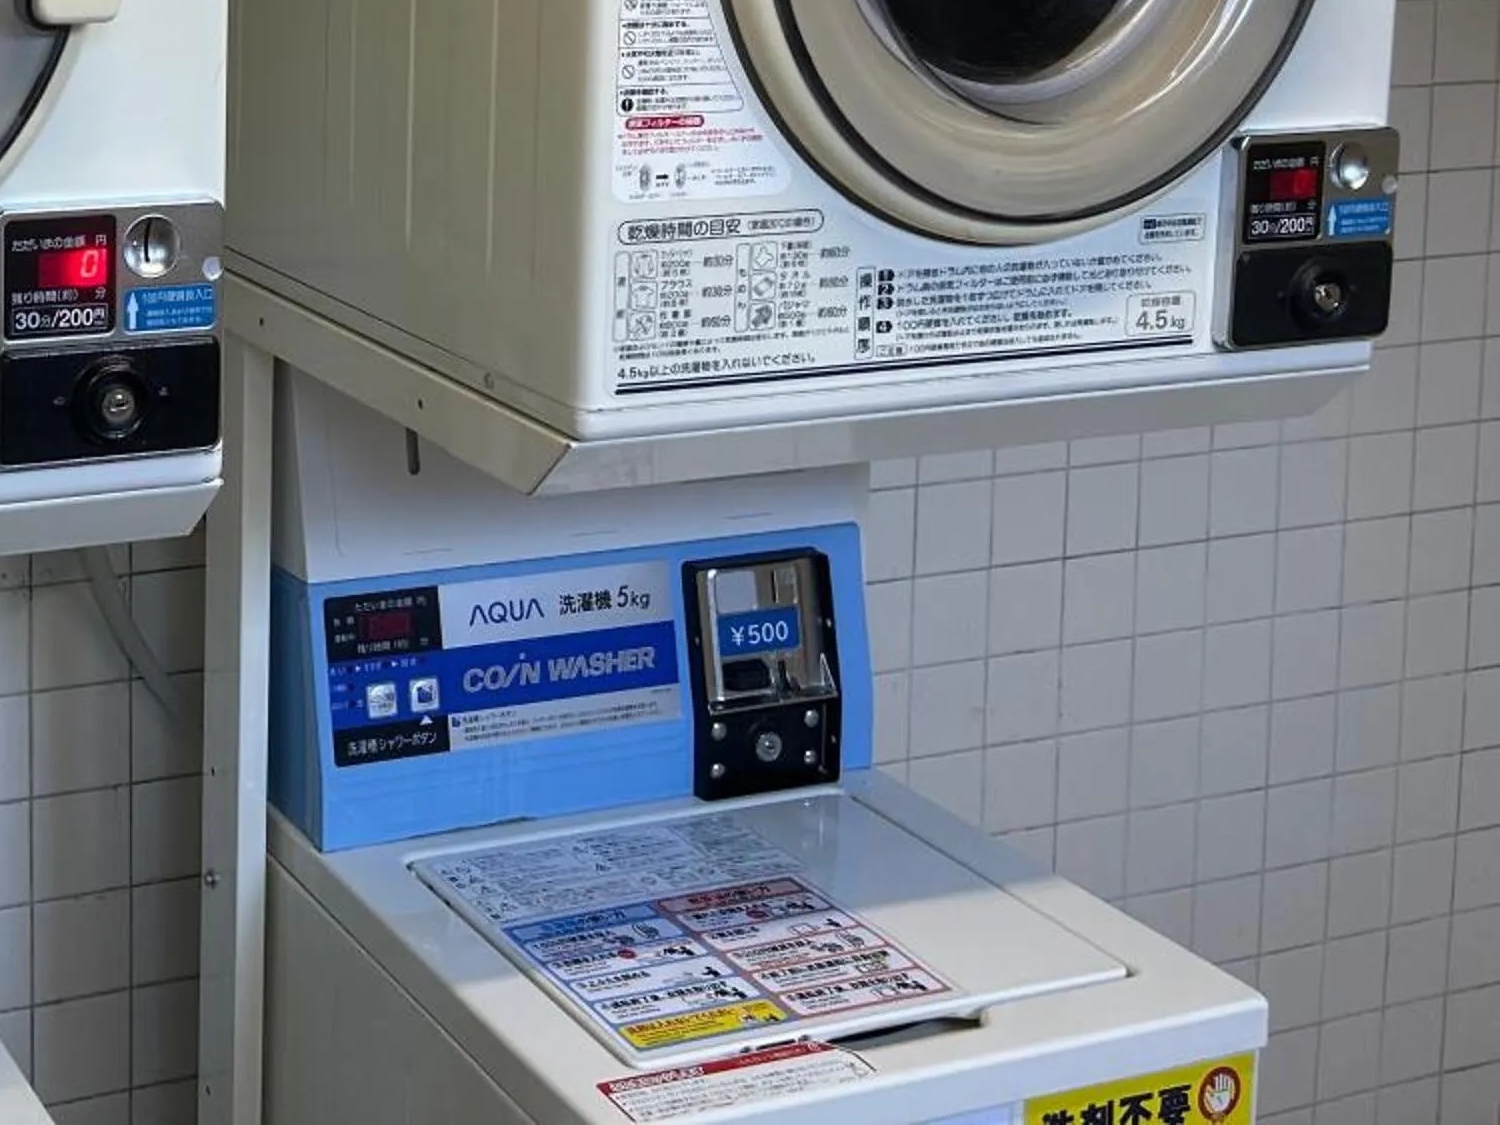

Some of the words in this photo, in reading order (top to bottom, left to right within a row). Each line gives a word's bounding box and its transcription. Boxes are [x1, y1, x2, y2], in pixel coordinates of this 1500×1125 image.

[80, 249, 100, 279] 0
[1135, 310, 1167, 330] 4.5
[469, 596, 545, 628] AQUA
[558, 591, 613, 616] 洗濯機
[616, 584, 651, 611] 5kg
[730, 620, 790, 647] ¥500
[547, 646, 656, 683] WASHER
